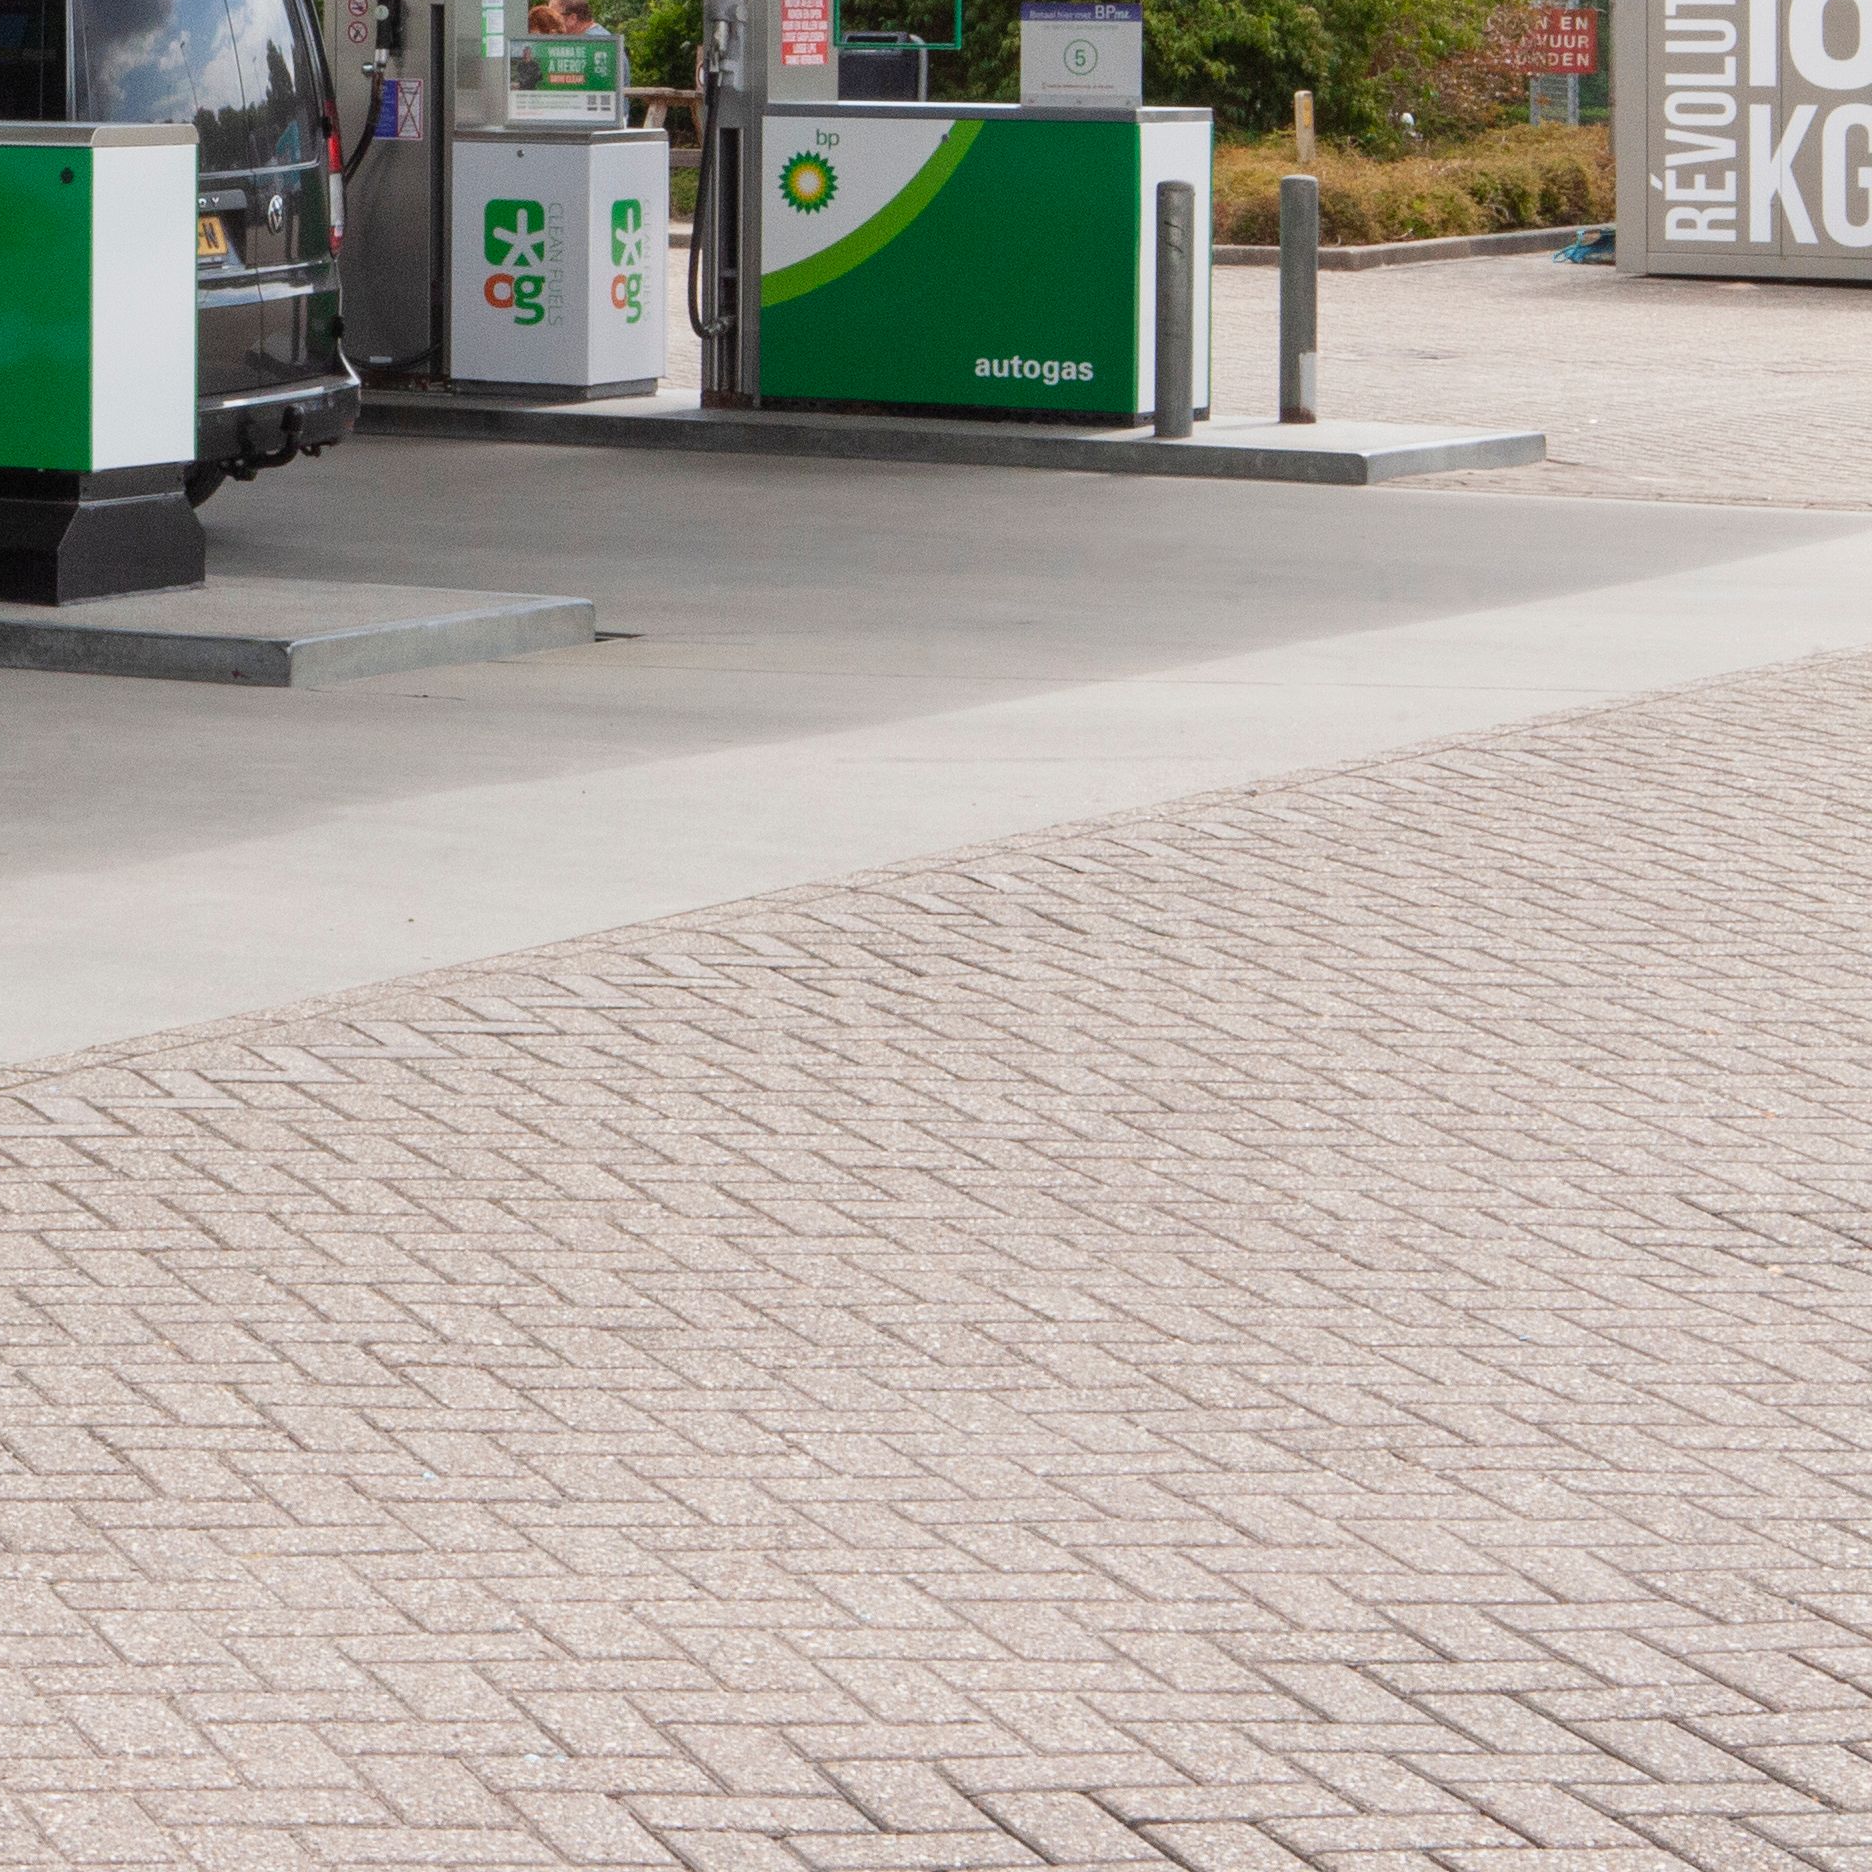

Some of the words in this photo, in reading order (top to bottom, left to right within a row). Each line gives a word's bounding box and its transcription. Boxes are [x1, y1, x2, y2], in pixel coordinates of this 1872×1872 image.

[1075, 48, 1087, 68] 5
[816, 129, 841, 150] bp
[974, 354, 1094, 385] autogas
